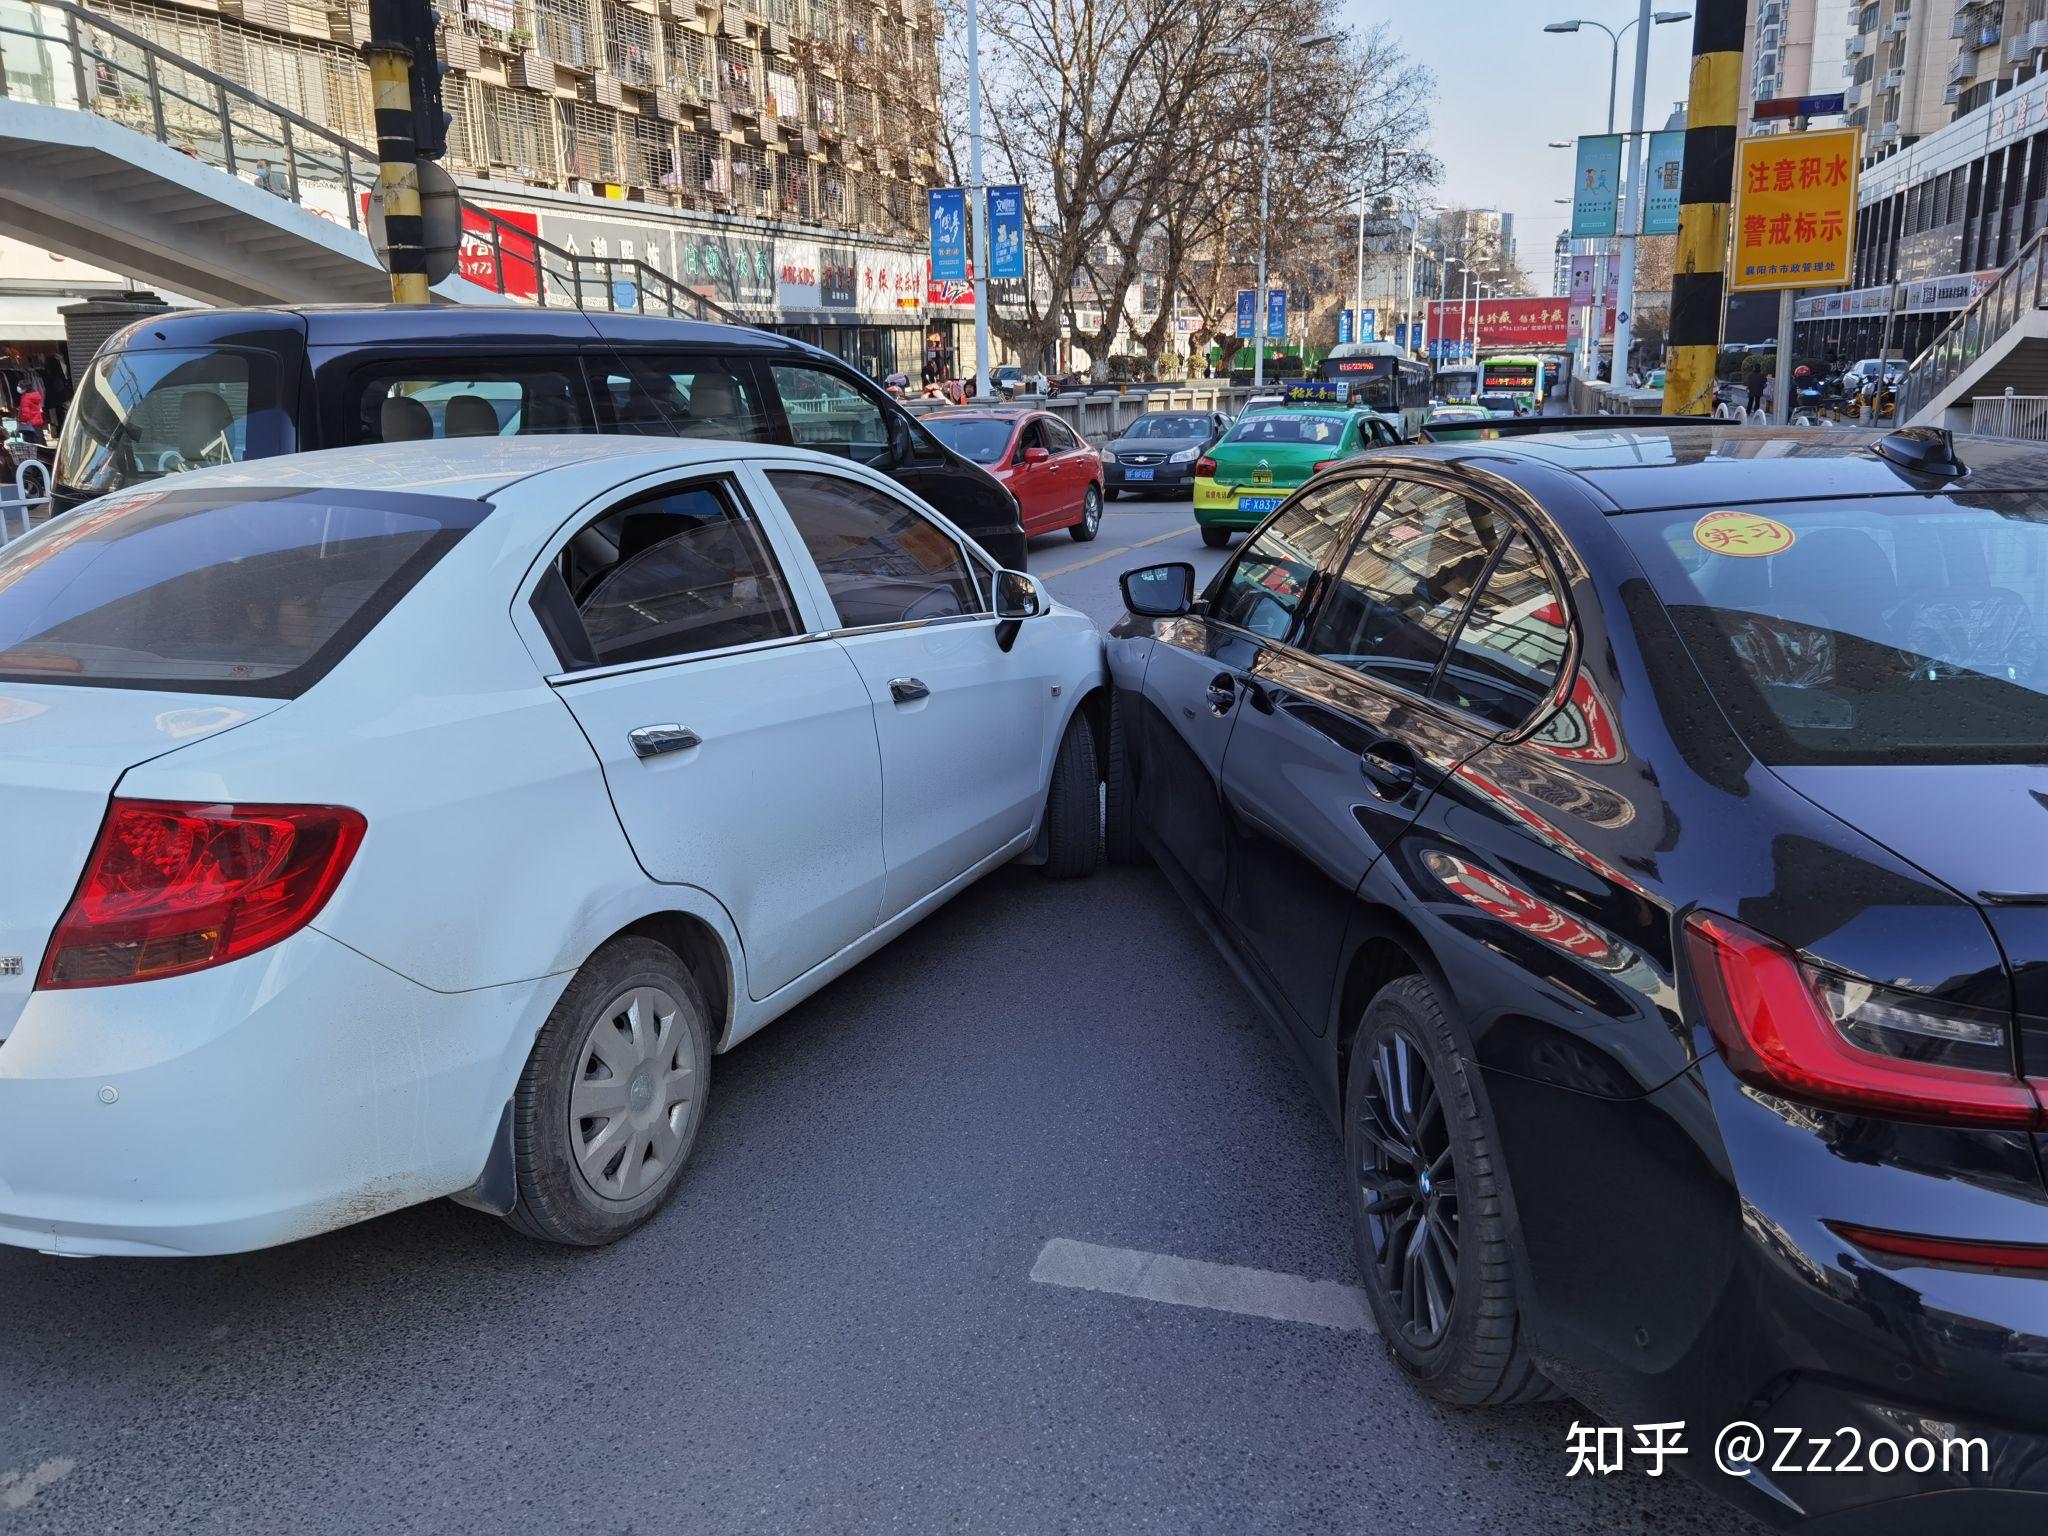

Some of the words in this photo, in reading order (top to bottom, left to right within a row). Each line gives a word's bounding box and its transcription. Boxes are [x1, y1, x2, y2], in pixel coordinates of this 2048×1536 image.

[1748, 154, 1848, 194] 注意积水
[1744, 210, 1844, 248] 警戒标示
[1745, 261, 1836, 276] 襄阳市市政管理处
